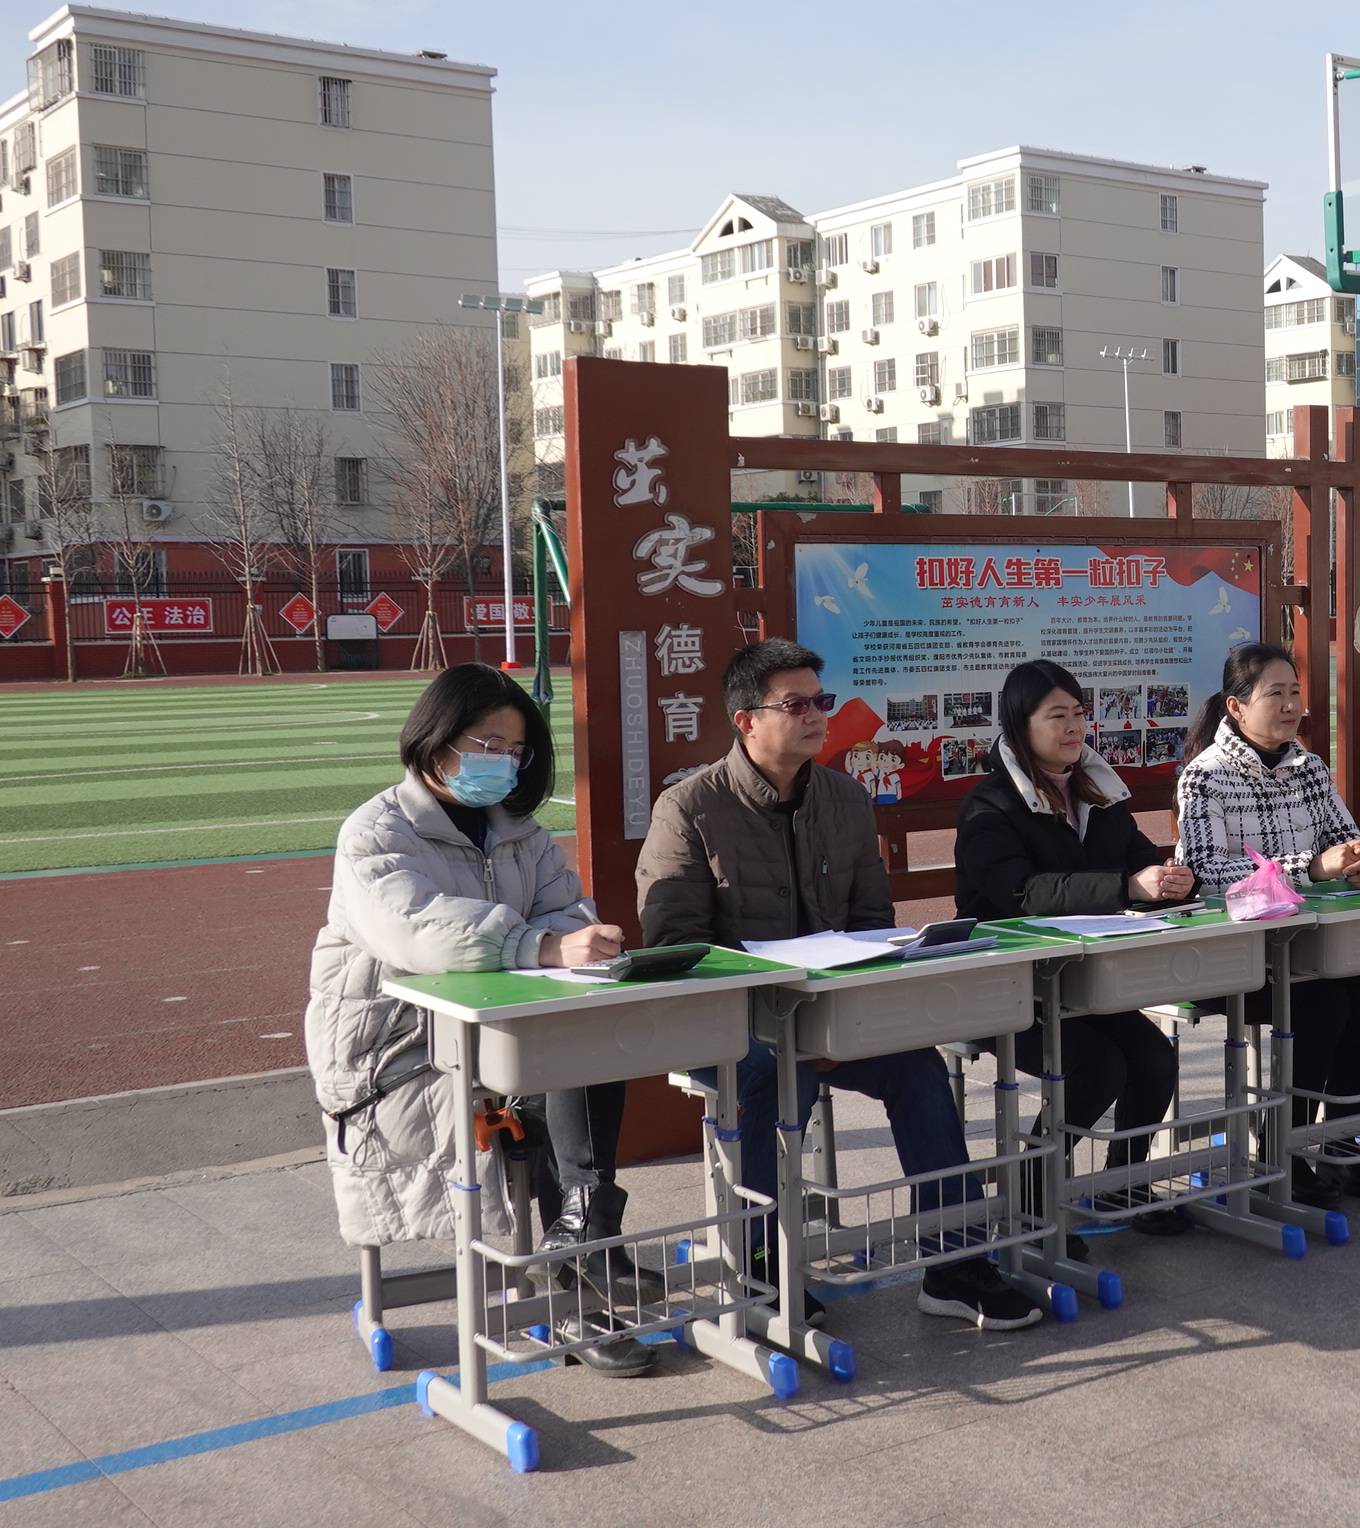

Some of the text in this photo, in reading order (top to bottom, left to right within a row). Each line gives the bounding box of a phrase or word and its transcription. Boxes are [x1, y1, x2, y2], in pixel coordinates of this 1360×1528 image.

[915, 556, 1168, 589] 扣好人生第一粒扣子
[624, 640, 646, 826] ZHUOSHIDEYU
